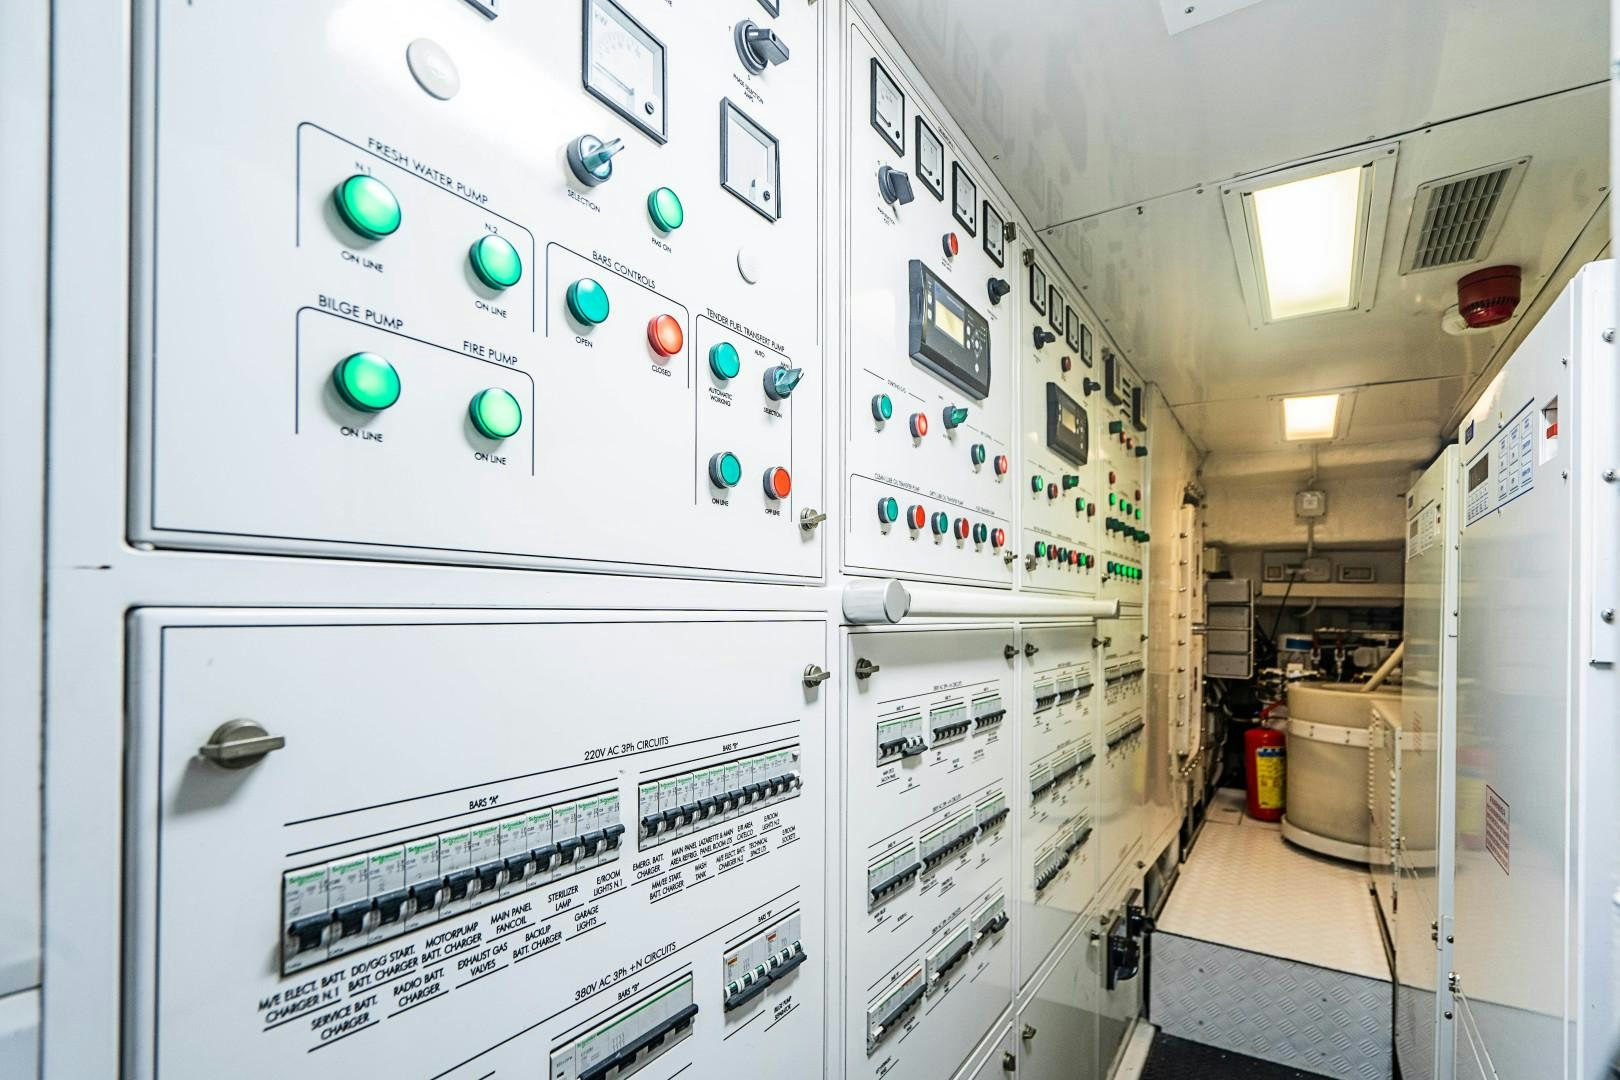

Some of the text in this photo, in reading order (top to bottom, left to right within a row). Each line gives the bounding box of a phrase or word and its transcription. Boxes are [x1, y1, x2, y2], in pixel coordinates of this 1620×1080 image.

[368, 137, 489, 206] FRESH WATER PUMP
[567, 189, 601, 213] SELECTION
[662, 243, 672, 254] ON
[340, 250, 384, 274] ON LINE
[592, 250, 656, 290] BARS CONTROLS
[318, 293, 404, 331] BILGE PUMP
[474, 299, 508, 320] ON LINE
[706, 307, 730, 327] TENDER
[729, 319, 743, 334] FUEL
[463, 340, 519, 366] FIRE PUMP
[575, 335, 594, 349] OPEN
[651, 364, 672, 378] CLOSED
[340, 425, 384, 443] ON LINE
[474, 451, 507, 467] ON LINE
[711, 496, 720, 506] ON
[584, 735, 669, 761] 220V AC 3Ph CIRCUITS
[469, 798, 488, 811] BARS
[596, 869, 621, 885] E/ROOM
[636, 865, 661, 880] CHARGER
[548, 885, 579, 903] STERILIZER
[593, 883, 613, 897] LIGHTS
[662, 880, 684, 895] CHARGER
[490, 902, 533, 925] MAIN PANEL
[555, 898, 572, 912] LAMP
[574, 905, 599, 922] GARAGE
[425, 921, 479, 949] MOTORPUMP
[496, 915, 527, 935] FANCOIL
[525, 924, 552, 943] BACKUP
[576, 916, 597, 932] LIGHTS
[421, 932, 482, 964] BATT. CHARGER
[457, 942, 508, 971] EXHAUST GAS
[512, 931, 563, 959] BATT. CHARGER
[348, 957, 419, 993] BATT. CHARGER
[470, 959, 496, 977] VALVES
[574, 981, 597, 1001] 380V
[598, 974, 611, 989] AC
[613, 966, 627, 981] 3Ph
[644, 941, 676, 965] CIRCUITS
[258, 993, 281, 1012] M/E
[321, 969, 346, 988] BATT.
[393, 967, 445, 997] RADIO BATT.
[398, 982, 441, 1008] CHARGER
[617, 988, 631, 1000] BARS
[265, 995, 319, 1024] CHARGER
[311, 994, 379, 1031] SERVICE BATT.
[320, 1012, 370, 1041] CHARGER
